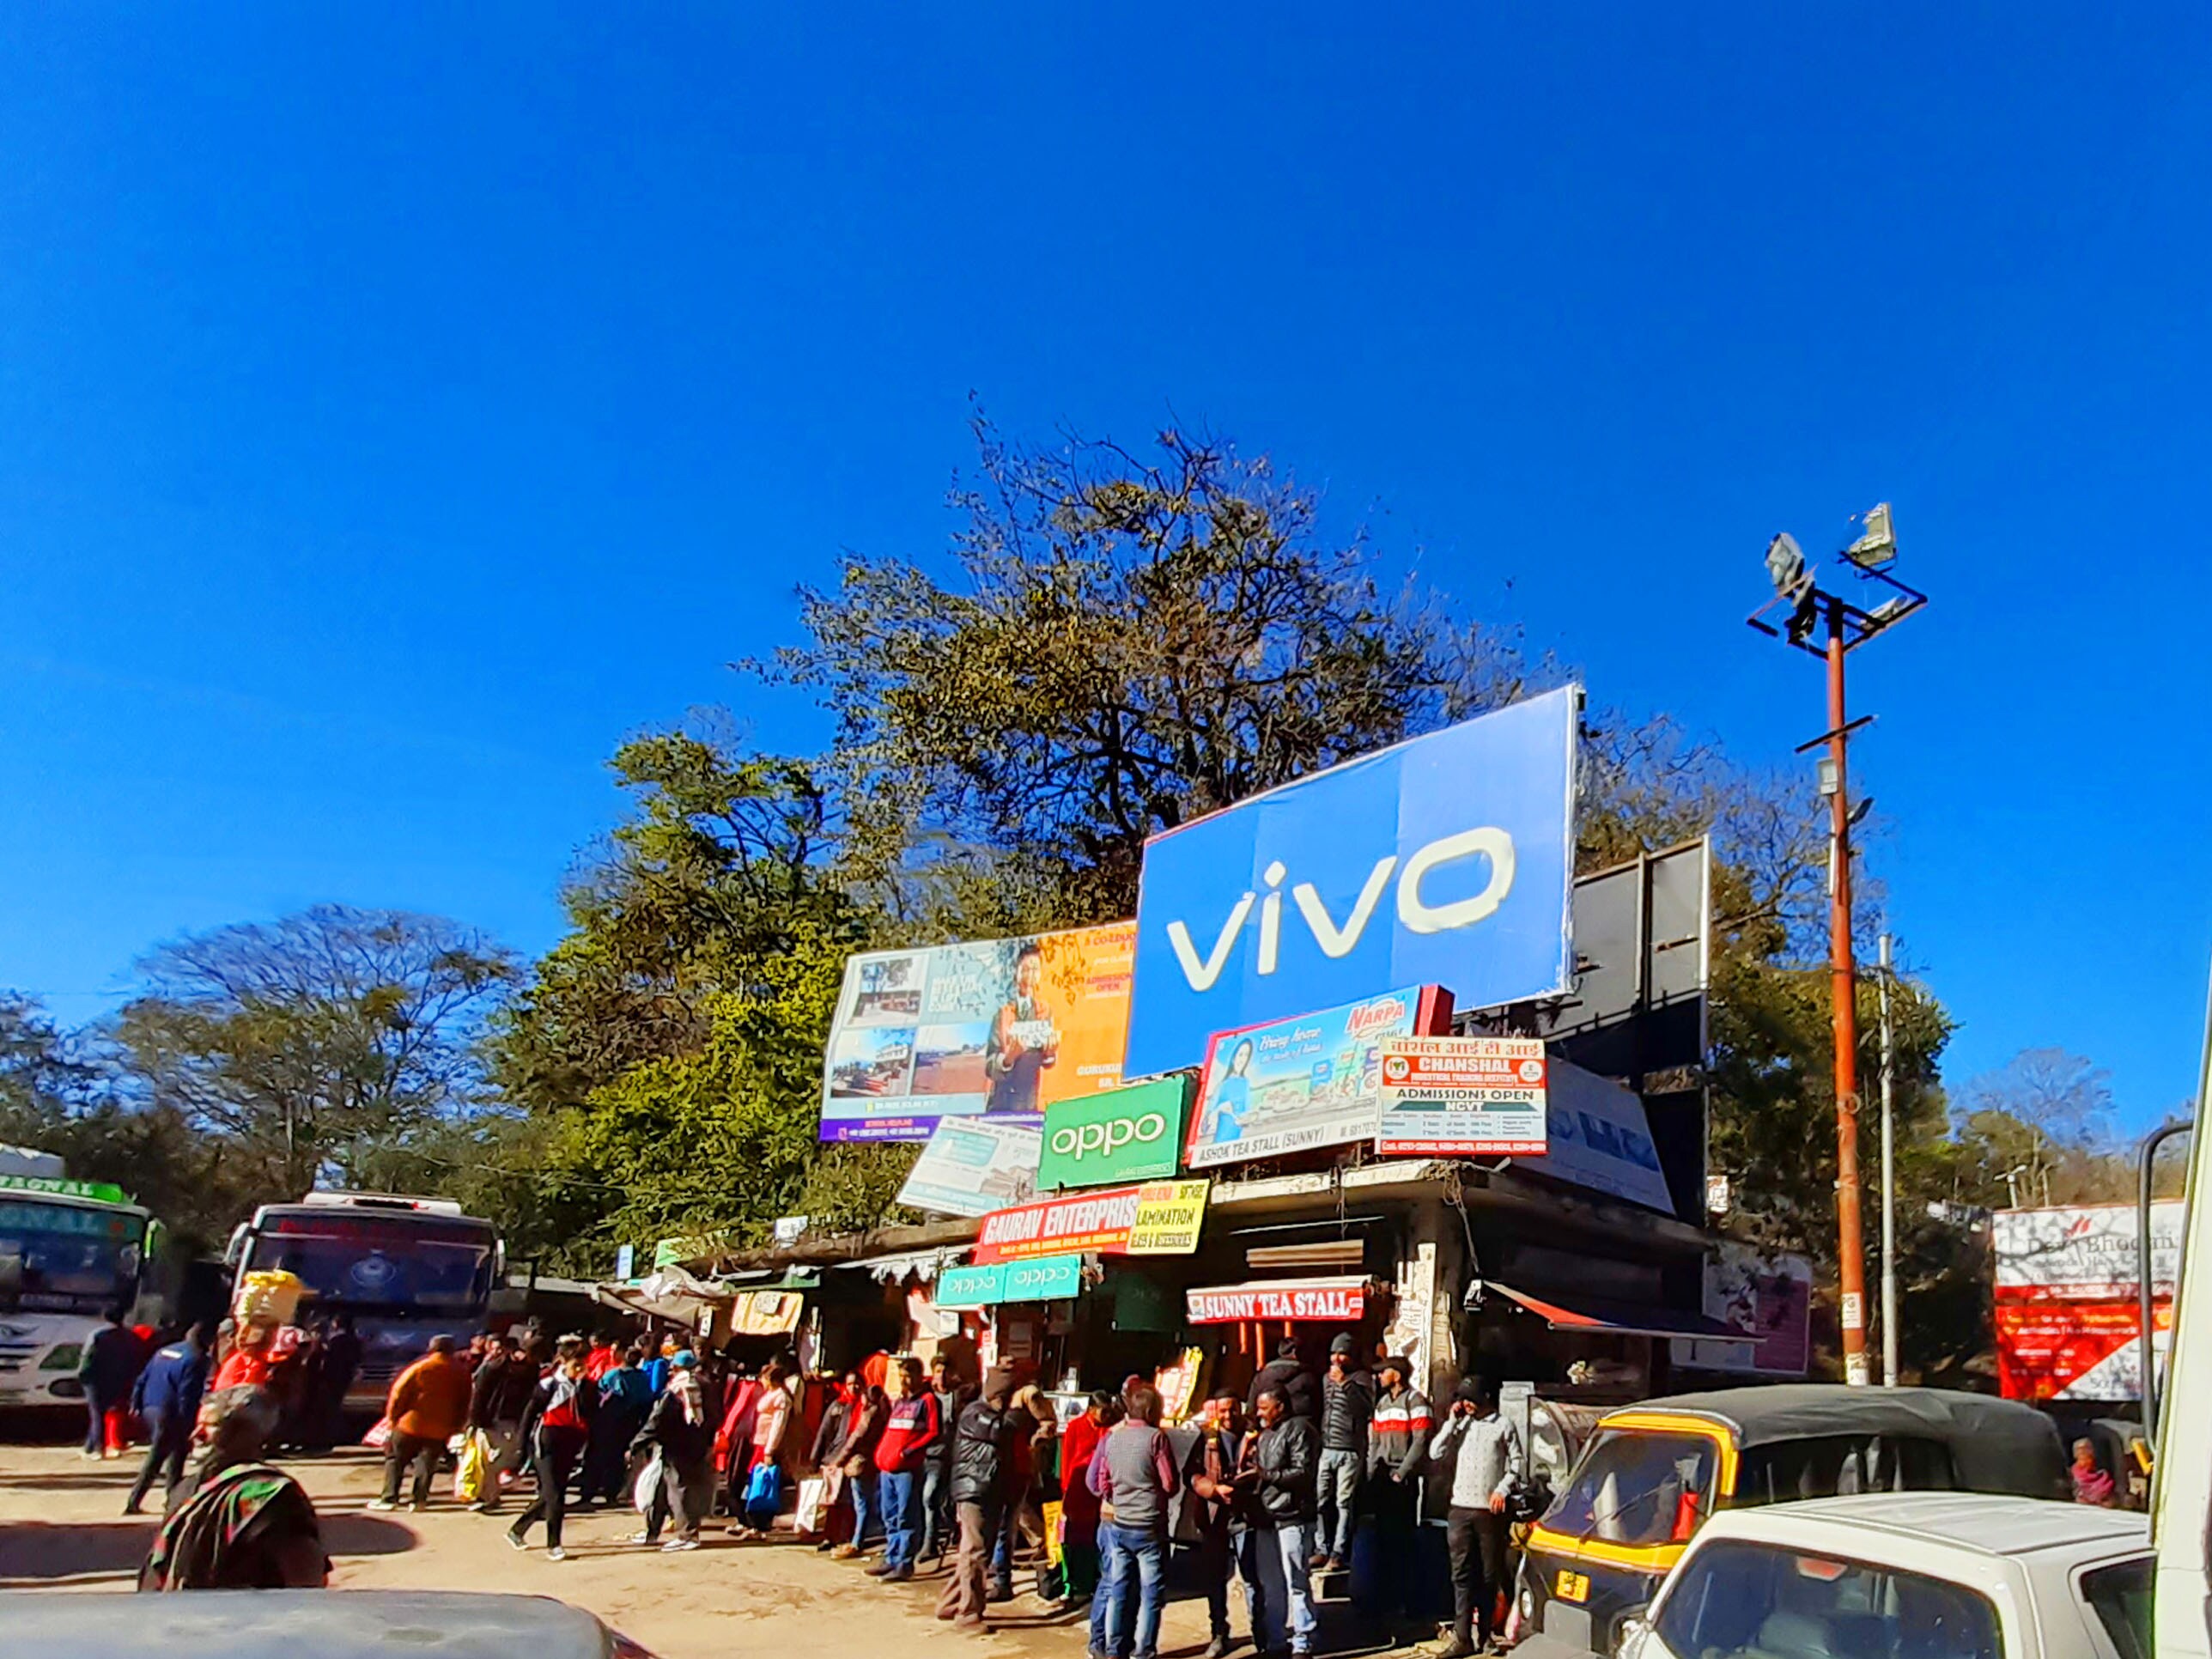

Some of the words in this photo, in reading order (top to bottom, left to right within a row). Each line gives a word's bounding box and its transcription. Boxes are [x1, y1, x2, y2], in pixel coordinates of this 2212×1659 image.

[1166, 826, 1516, 993] vivo
[1346, 1002, 1404, 1032] NARPA
[1419, 1056, 1511, 1073] CHANSHAL
[1397, 1088, 1486, 1100] ADMISSIONS
[1491, 1091, 1534, 1100] OPEN
[1445, 1101, 1484, 1112] NCVT
[1051, 1113, 1165, 1160] oppo
[1199, 1144, 1230, 1162] ASHOK
[1232, 1141, 1250, 1156] TEA
[1251, 1136, 1279, 1152] STALL
[1281, 1126, 1324, 1150] (SUNNY)
[983, 1207, 1045, 1245] GAURAV
[1135, 1207, 1195, 1226] LAMINATION
[1206, 1294, 1256, 1318] SUNNY
[1258, 1292, 1293, 1316] TEA
[1294, 1291, 1350, 1317] STALL
